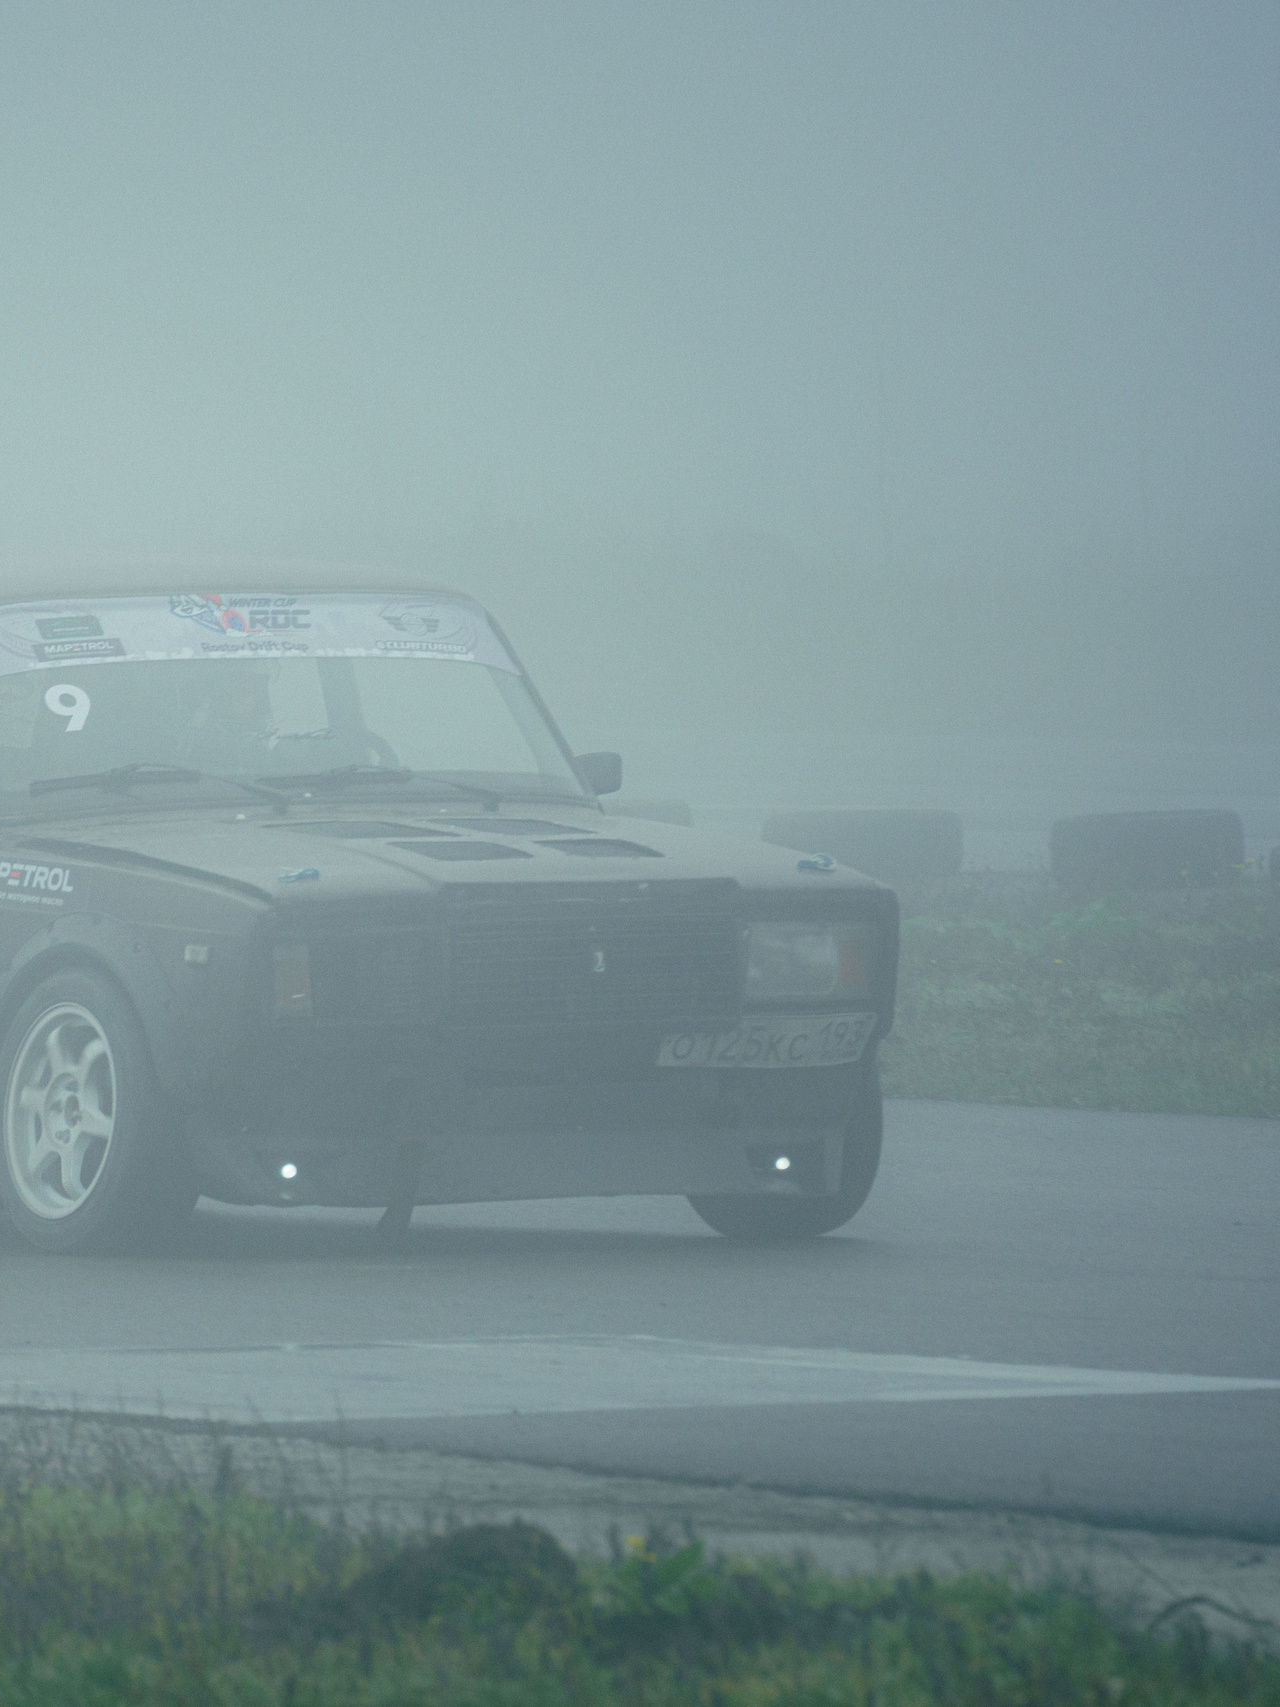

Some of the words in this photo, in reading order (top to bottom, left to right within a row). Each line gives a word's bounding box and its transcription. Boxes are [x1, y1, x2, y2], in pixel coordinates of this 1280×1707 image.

[229, 598, 271, 608] WINTER
[273, 597, 297, 607] CUP
[249, 609, 311, 629] RDC
[44, 640, 114, 654] MAPETROL
[248, 640, 280, 652] Drift
[282, 641, 309, 653] Cup
[43, 683, 92, 734] 9
